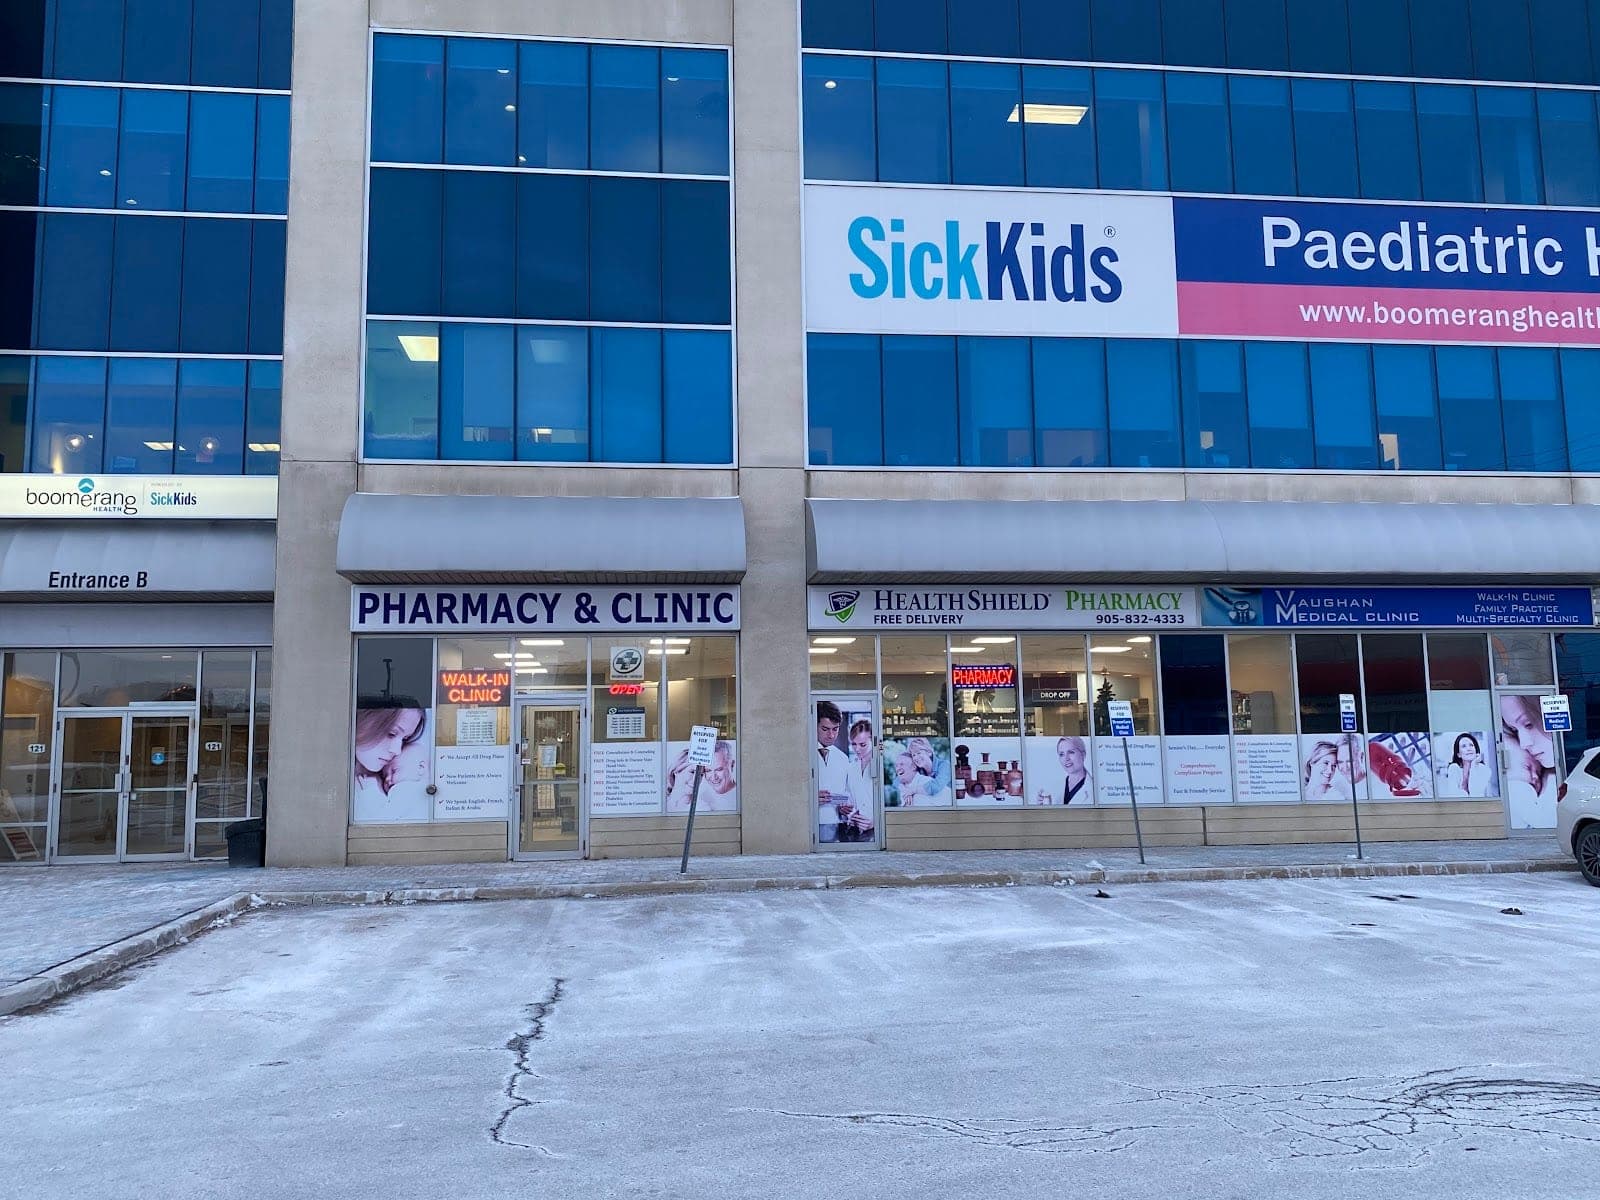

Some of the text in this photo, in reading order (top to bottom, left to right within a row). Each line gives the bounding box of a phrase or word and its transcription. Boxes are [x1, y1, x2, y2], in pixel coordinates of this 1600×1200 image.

[1262, 216, 1564, 276] Paediatric
[847, 216, 1123, 303] SickKids
[1299, 301, 1600, 332] www.boomeranghealt
[26, 488, 138, 515] boomerang
[150, 492, 197, 505] SickKids
[49, 571, 148, 588] Entrance B
[1065, 590, 1183, 610] PHARMACY
[1522, 592, 1556, 601] CLINIC
[358, 592, 734, 624] PHARMACY & CLINIC
[1474, 604, 1560, 613] FAMILY PRACTICE
[874, 614, 963, 624] FREE DELIVERY
[1096, 614, 1184, 624] 905-832-4333
[1546, 614, 1578, 623] CLINIC
[442, 672, 509, 686] WALK-IN
[953, 669, 1014, 685] PHARMACY
[448, 688, 502, 702] CLINIC
[608, 684, 644, 695] OPEN
